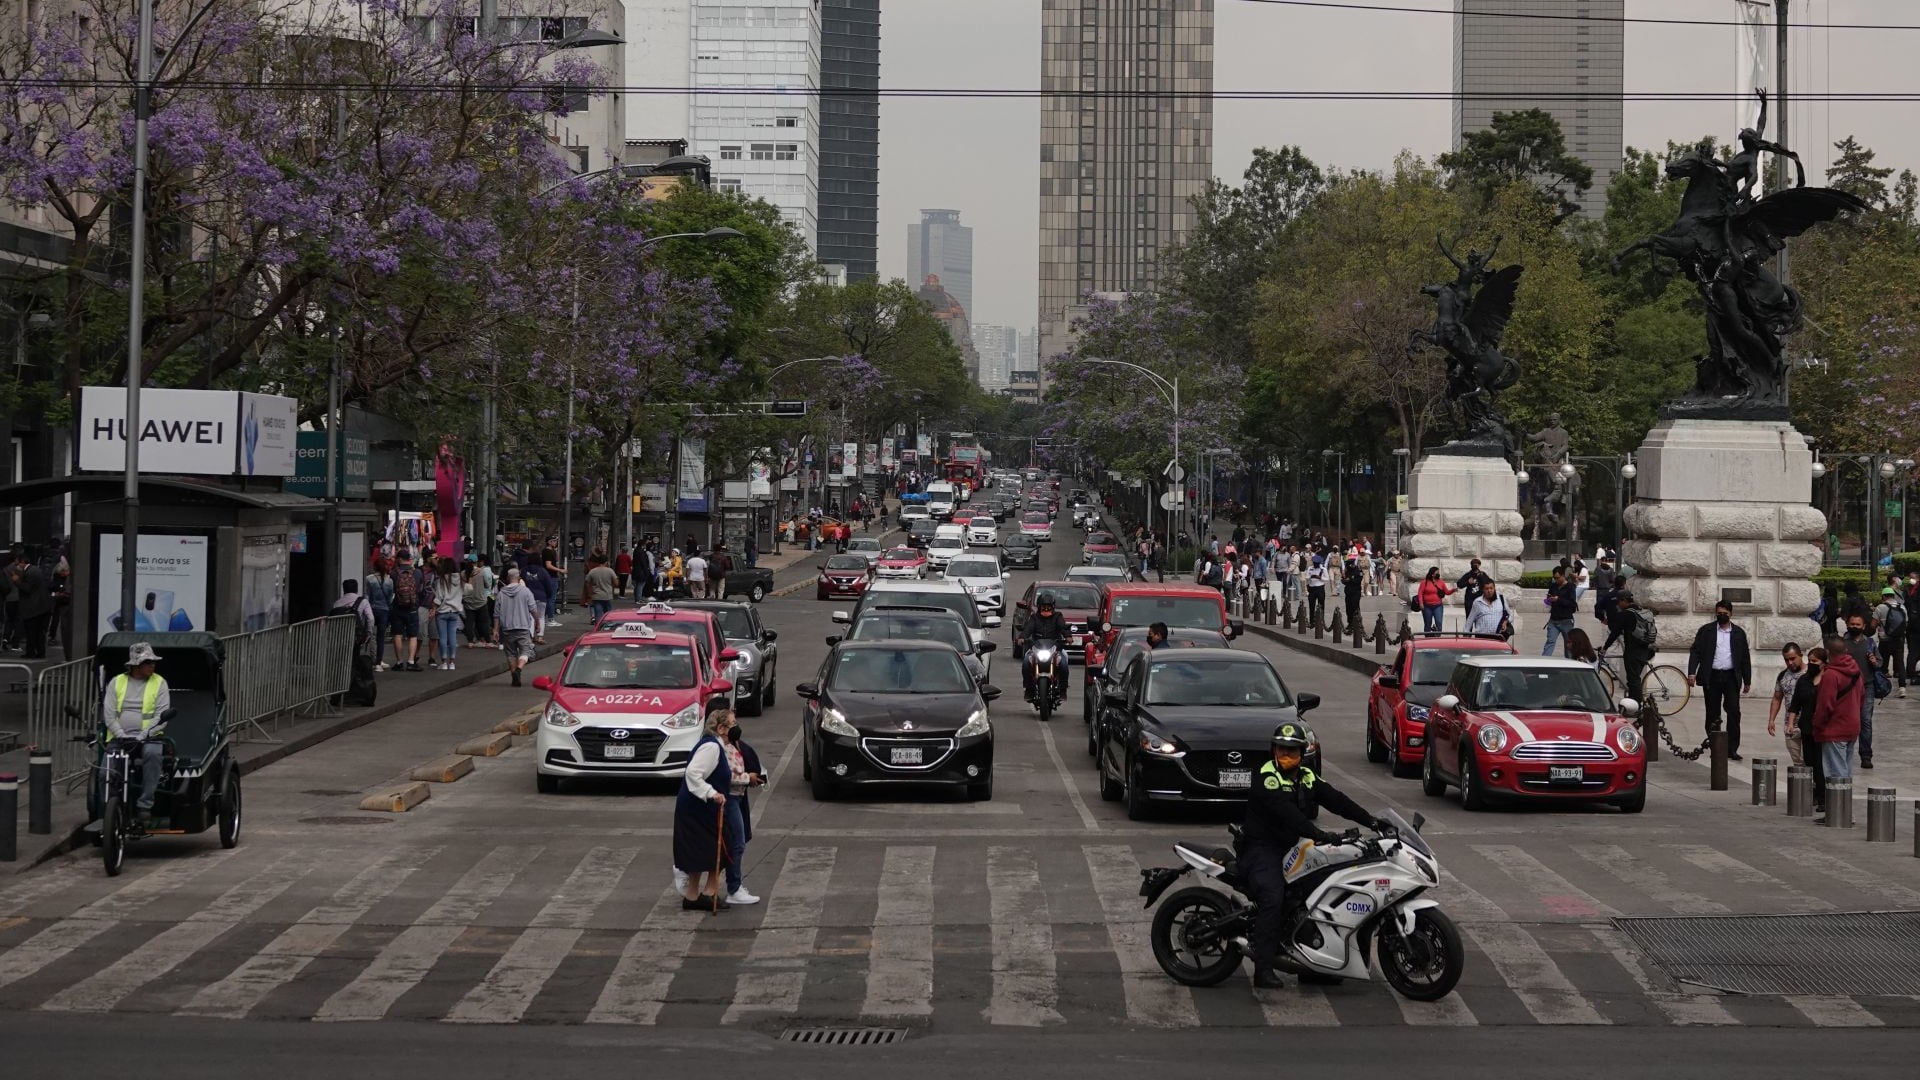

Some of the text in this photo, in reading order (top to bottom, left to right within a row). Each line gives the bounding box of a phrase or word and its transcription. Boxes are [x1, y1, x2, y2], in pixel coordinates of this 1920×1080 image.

[93, 417, 223, 444] HUAWEI
[116, 556, 150, 564] HWEI
[585, 694, 663, 706] A-0227-A
[1346, 902, 1371, 912] CDMX
